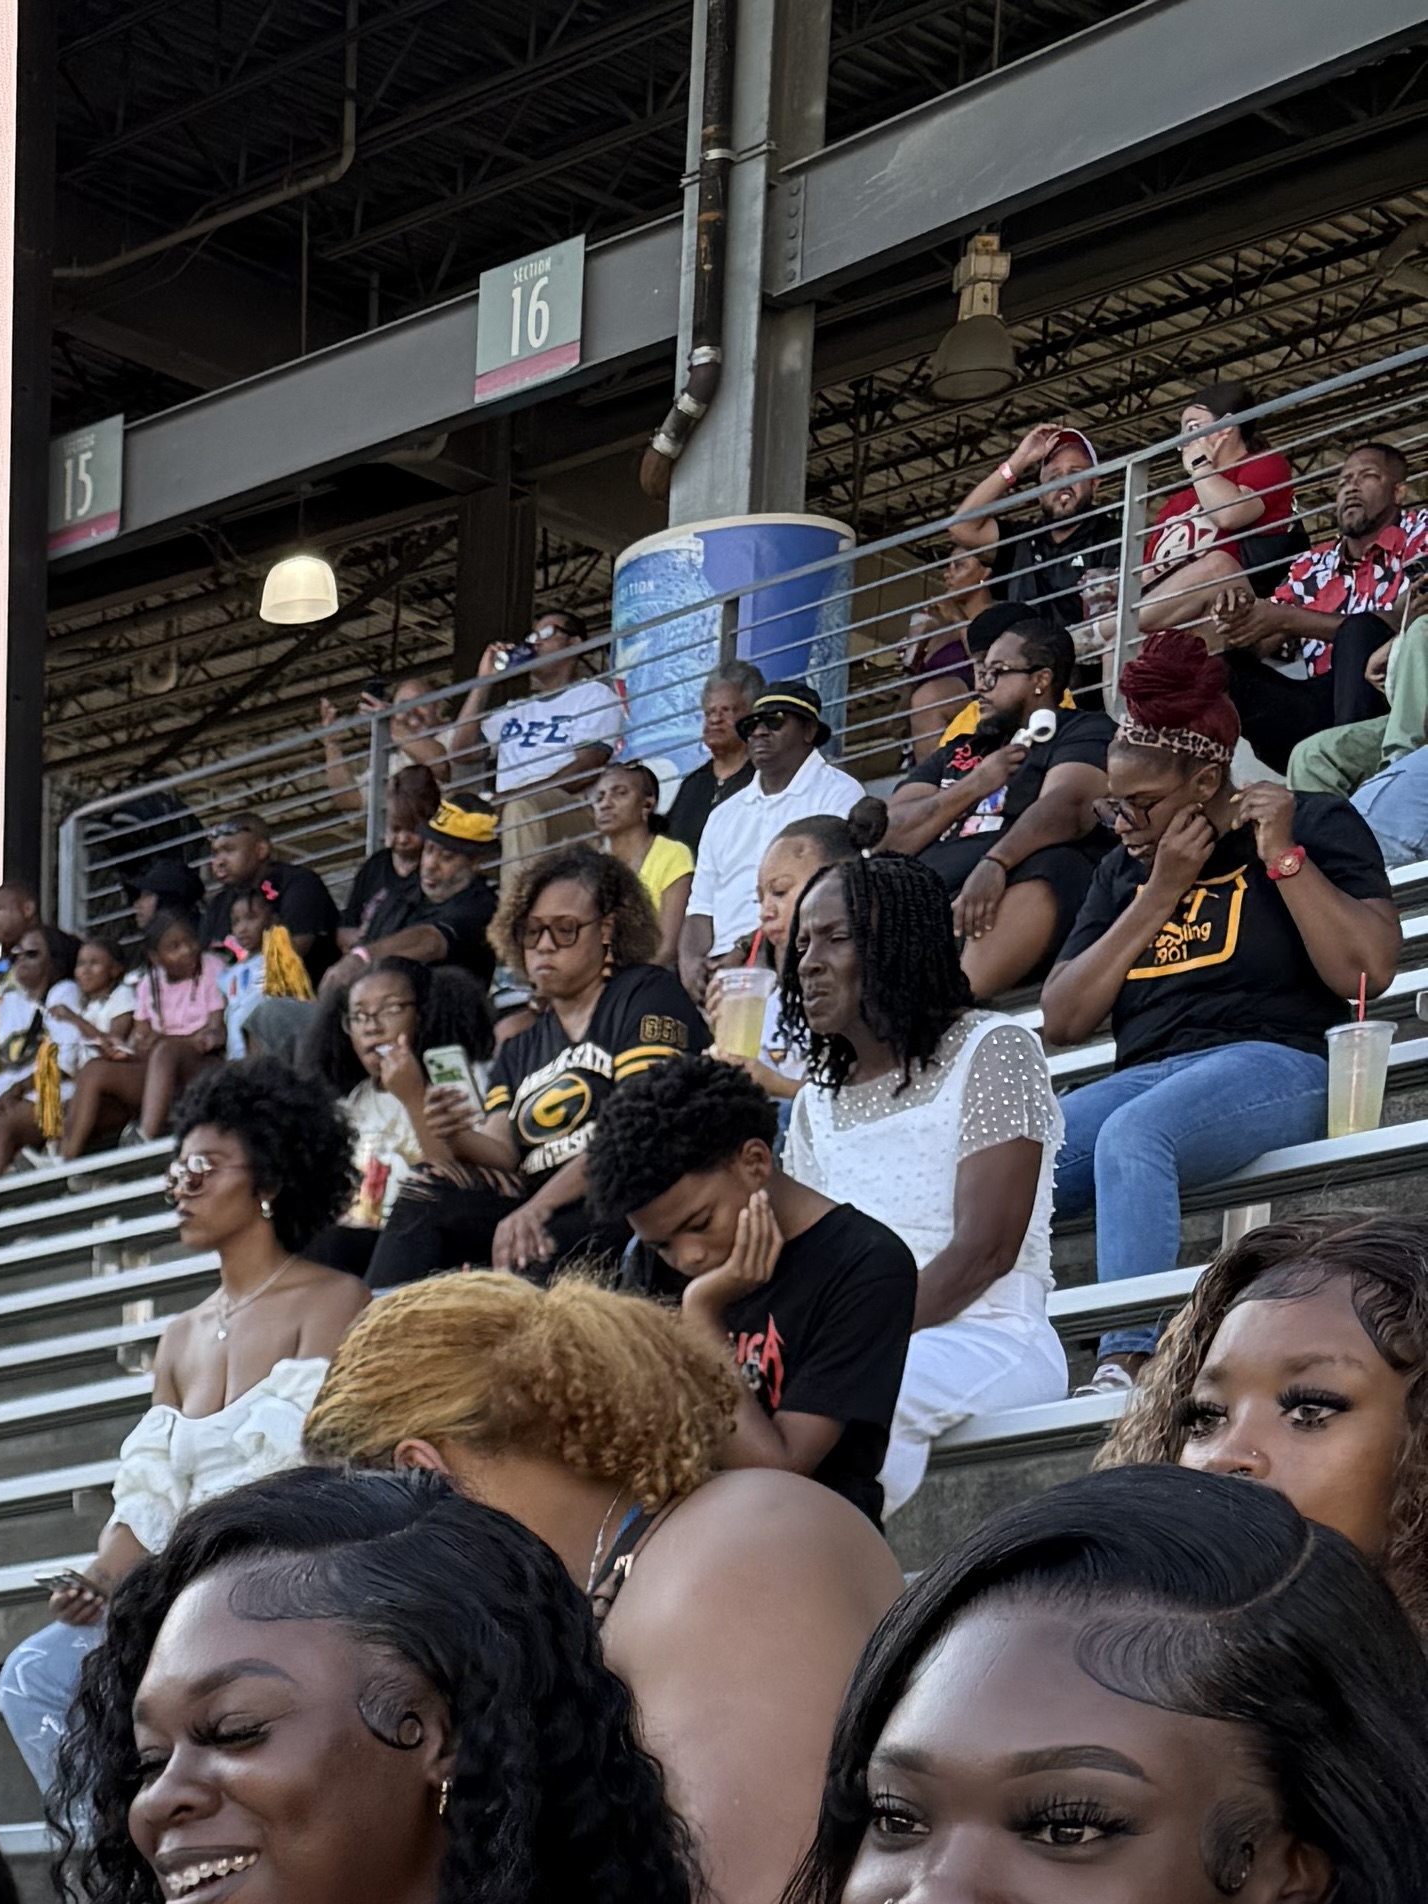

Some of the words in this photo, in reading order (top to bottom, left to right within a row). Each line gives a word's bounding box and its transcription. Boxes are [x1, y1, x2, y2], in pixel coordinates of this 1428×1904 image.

[513, 256, 552, 285] SECTION
[510, 276, 550, 357] 16
[64, 451, 94, 521] 15
